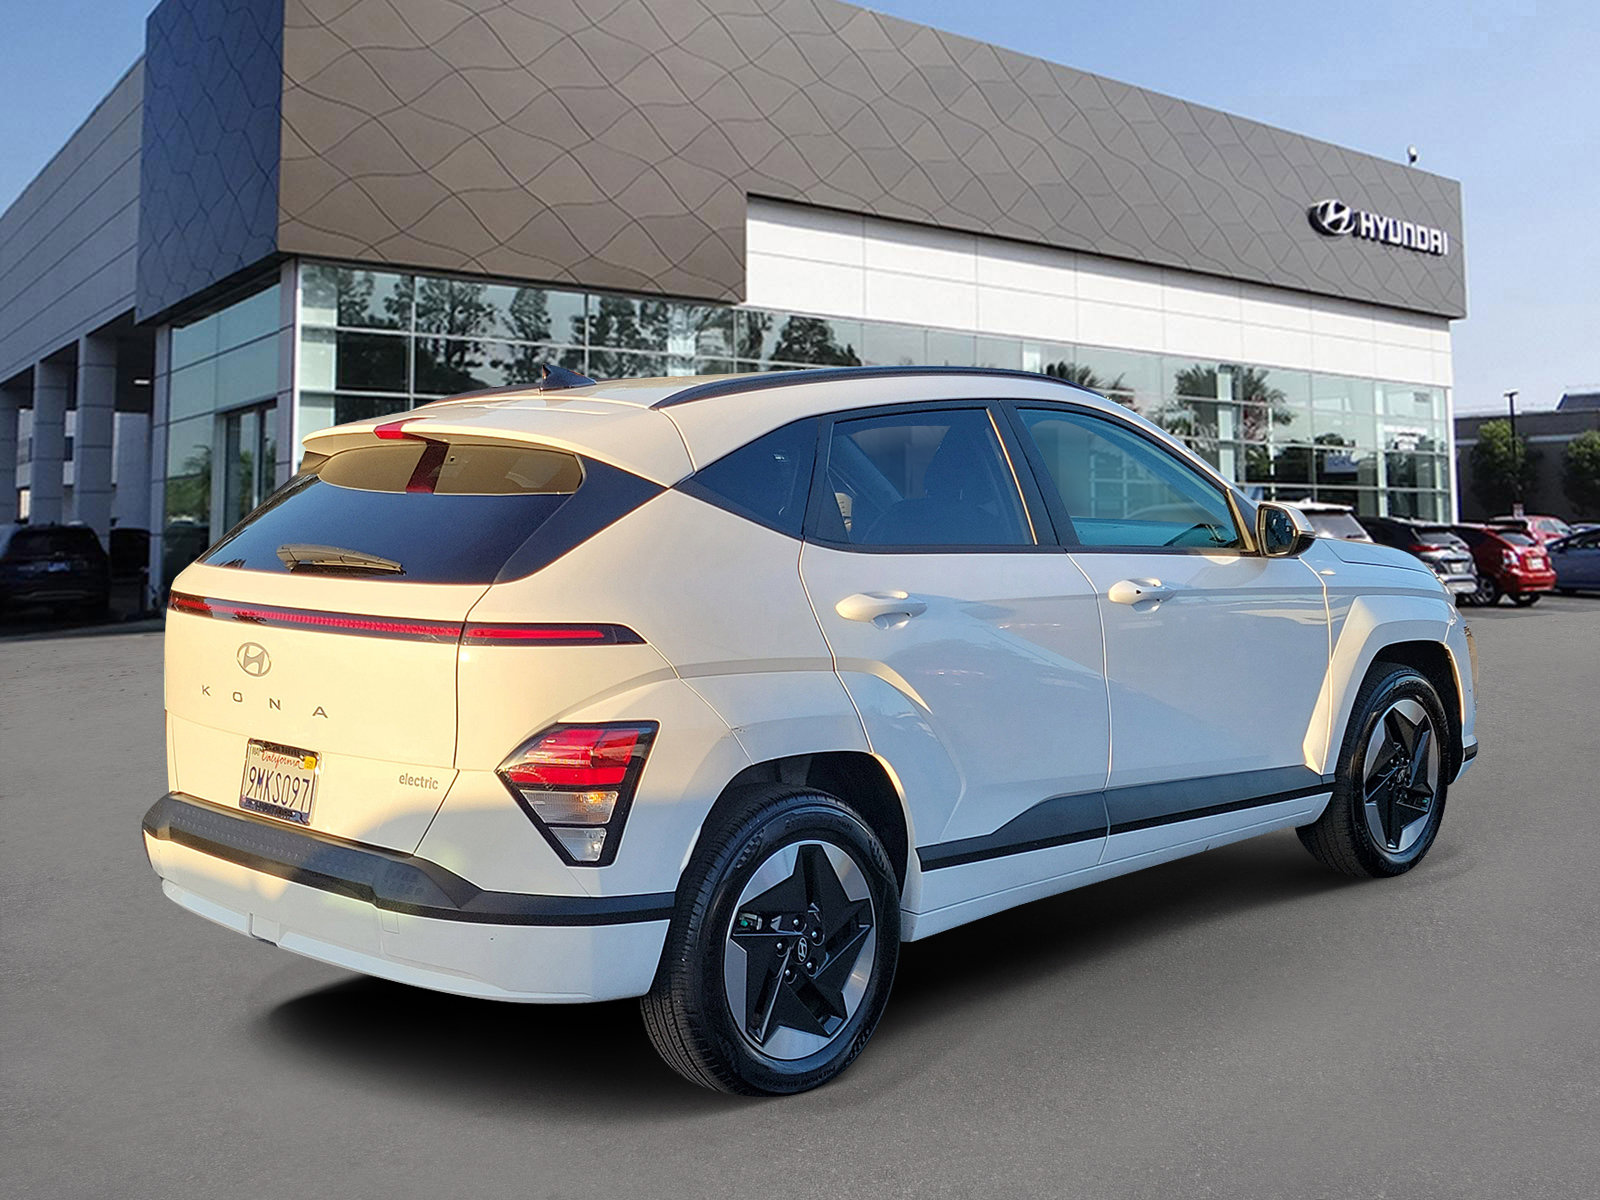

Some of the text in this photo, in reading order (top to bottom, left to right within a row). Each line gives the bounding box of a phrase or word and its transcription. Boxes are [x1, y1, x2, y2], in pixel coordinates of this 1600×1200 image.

[1360, 210, 1448, 255] HYUNDAI
[201, 685, 329, 719] KONA
[261, 750, 303, 769] California
[246, 766, 311, 812] 9MKS097
[398, 773, 439, 791] electric
